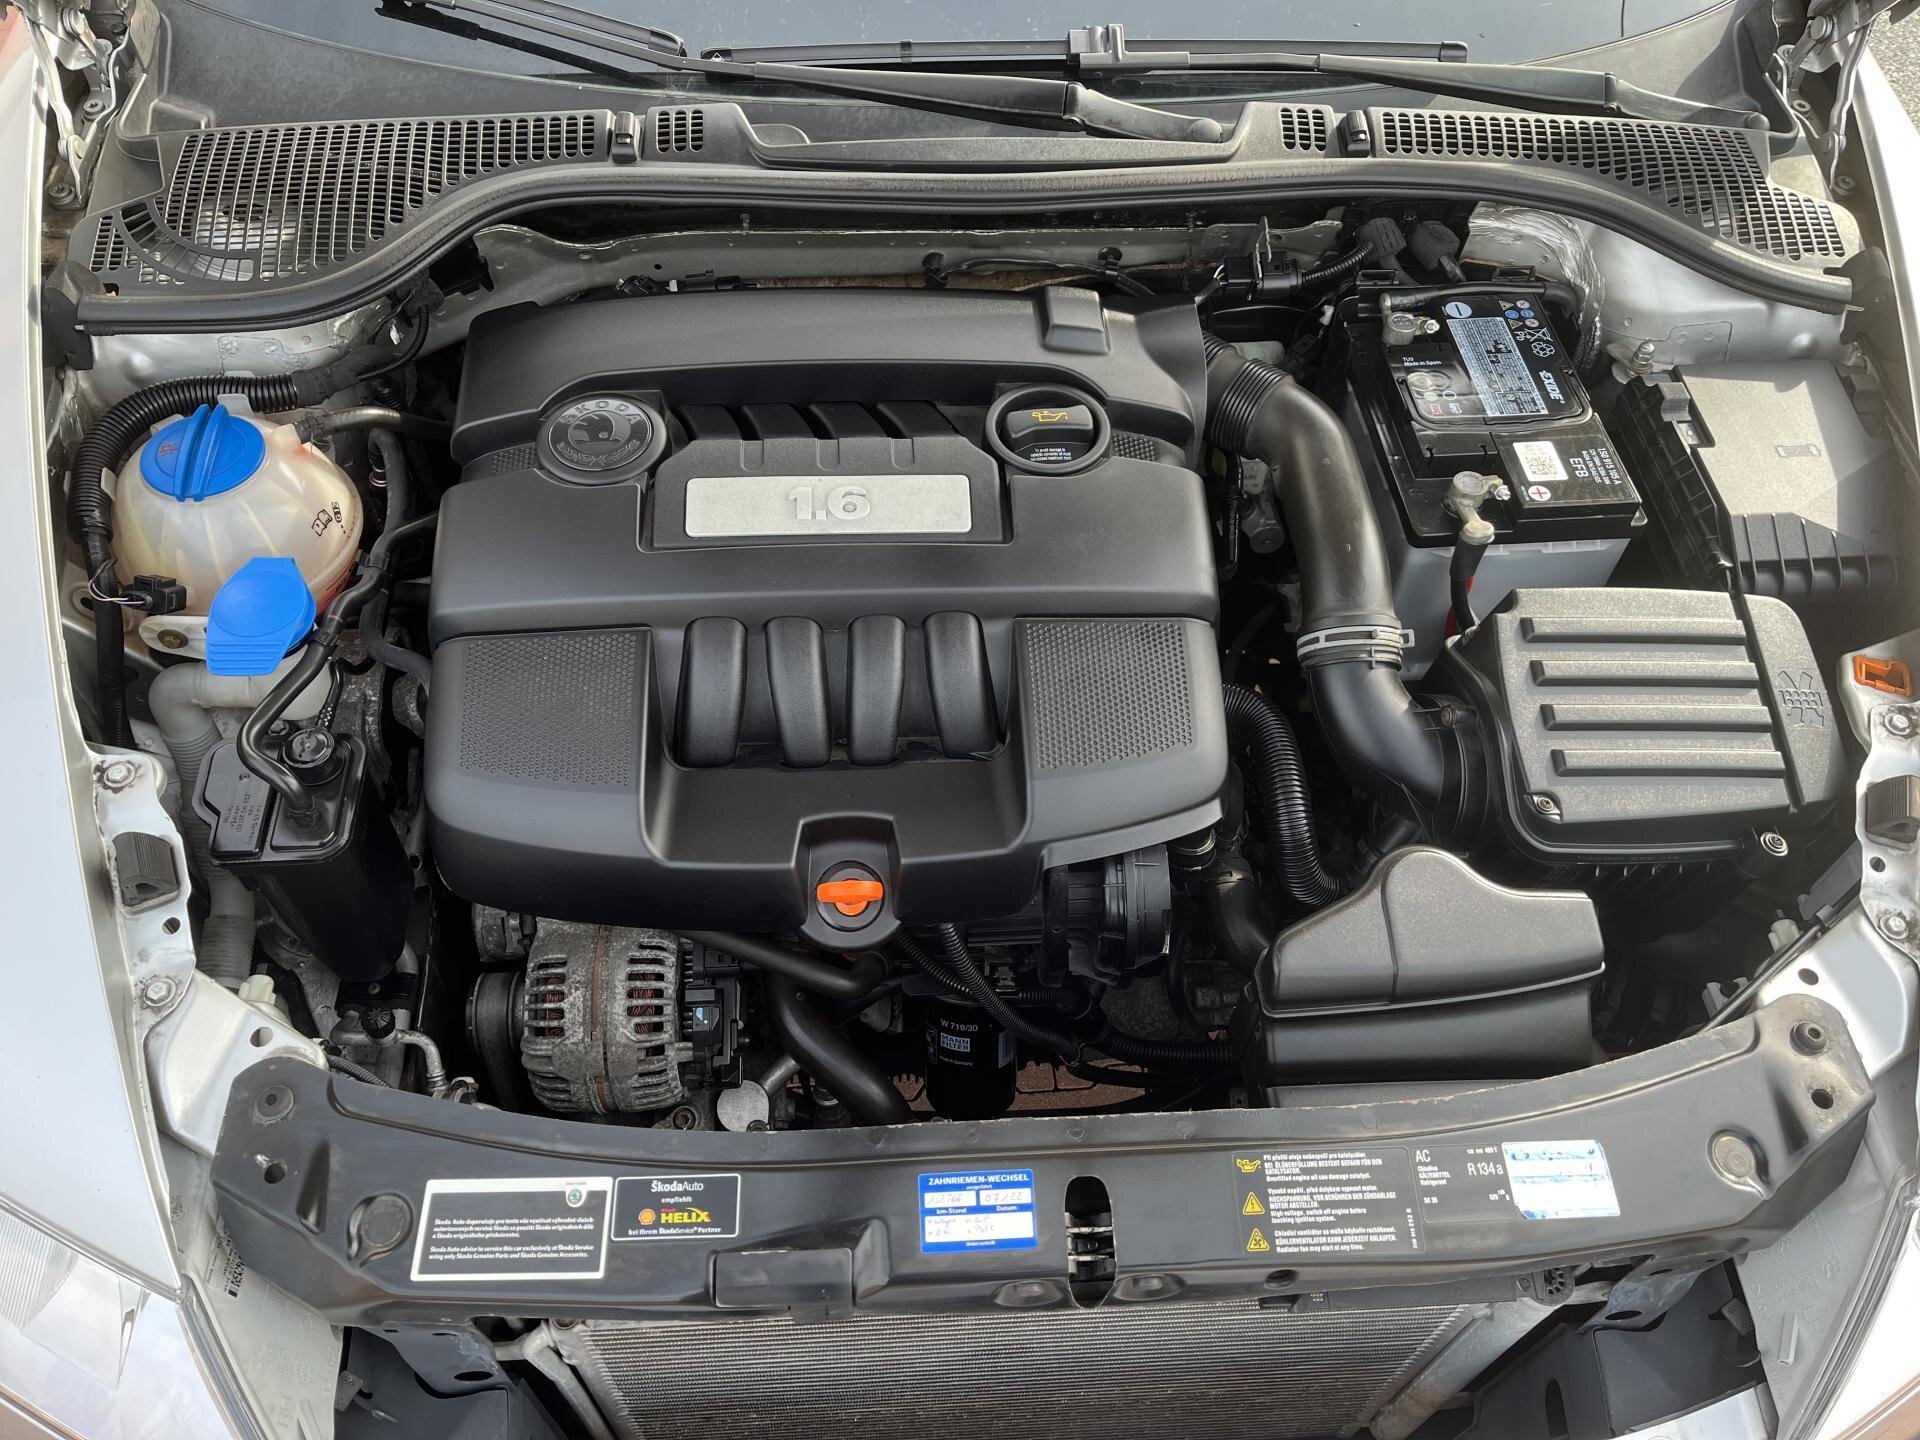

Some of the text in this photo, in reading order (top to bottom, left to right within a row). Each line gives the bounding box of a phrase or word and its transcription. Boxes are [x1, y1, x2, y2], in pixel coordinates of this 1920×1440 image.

[1514, 331, 1524, 341] Pb
[1539, 370, 1564, 400] EXIDE
[1570, 458, 1589, 477] EFB
[788, 485, 871, 520] 1.6
[940, 1018, 978, 1031] W 719/30
[942, 1034, 969, 1045] MANN
[1416, 1149, 1431, 1163] AC
[1467, 1162, 1504, 1176] R 134 a
[651, 1180, 704, 1192] ŠkodaAuto
[928, 1173, 1029, 1186] ZAHNRIEMEN-WECHSEL
[661, 1196, 692, 1204] empfiehlt
[661, 1208, 711, 1224] HELIX
